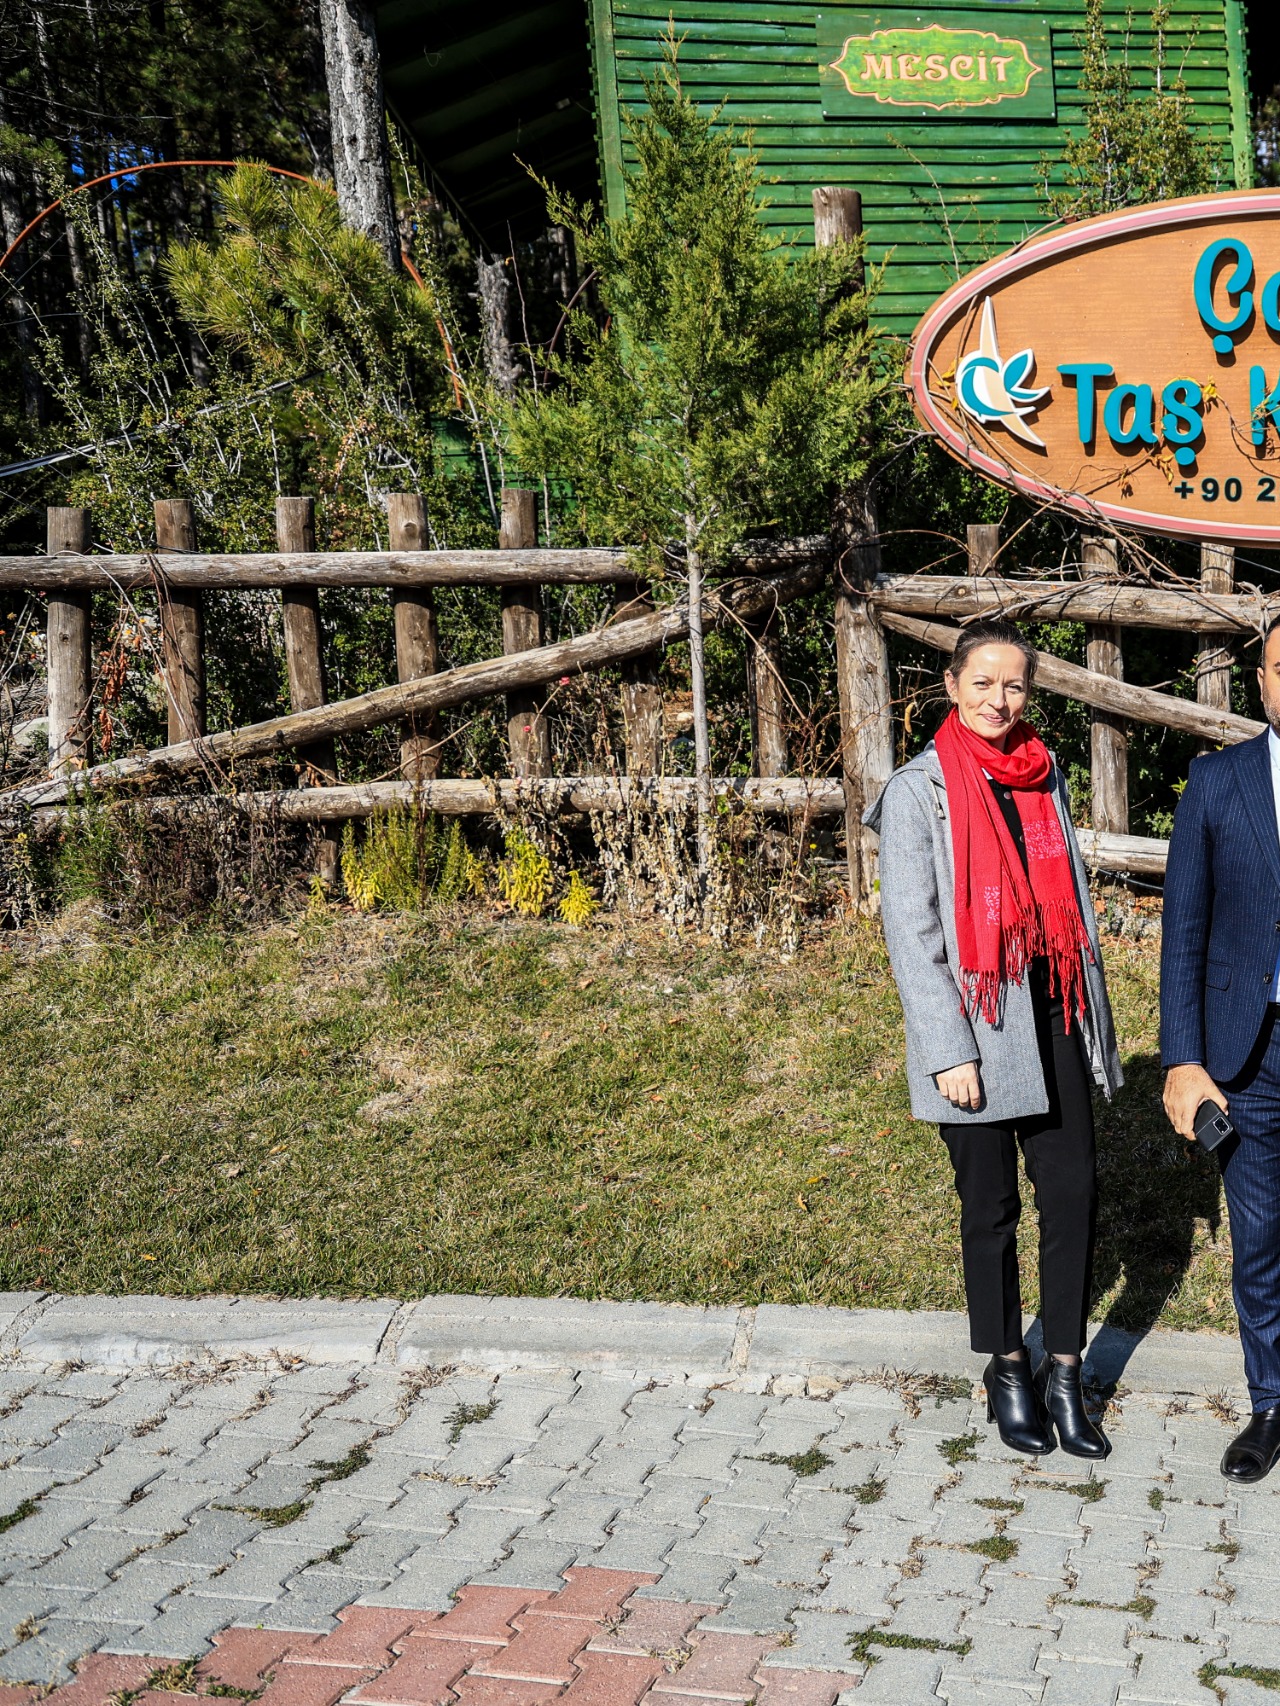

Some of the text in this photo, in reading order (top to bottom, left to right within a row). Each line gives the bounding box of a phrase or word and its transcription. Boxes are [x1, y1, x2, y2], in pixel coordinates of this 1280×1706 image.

[860, 50, 1014, 82] MESCİT
[1056, 363, 1203, 466] Taş
[1174, 477, 1243, 502] +90
